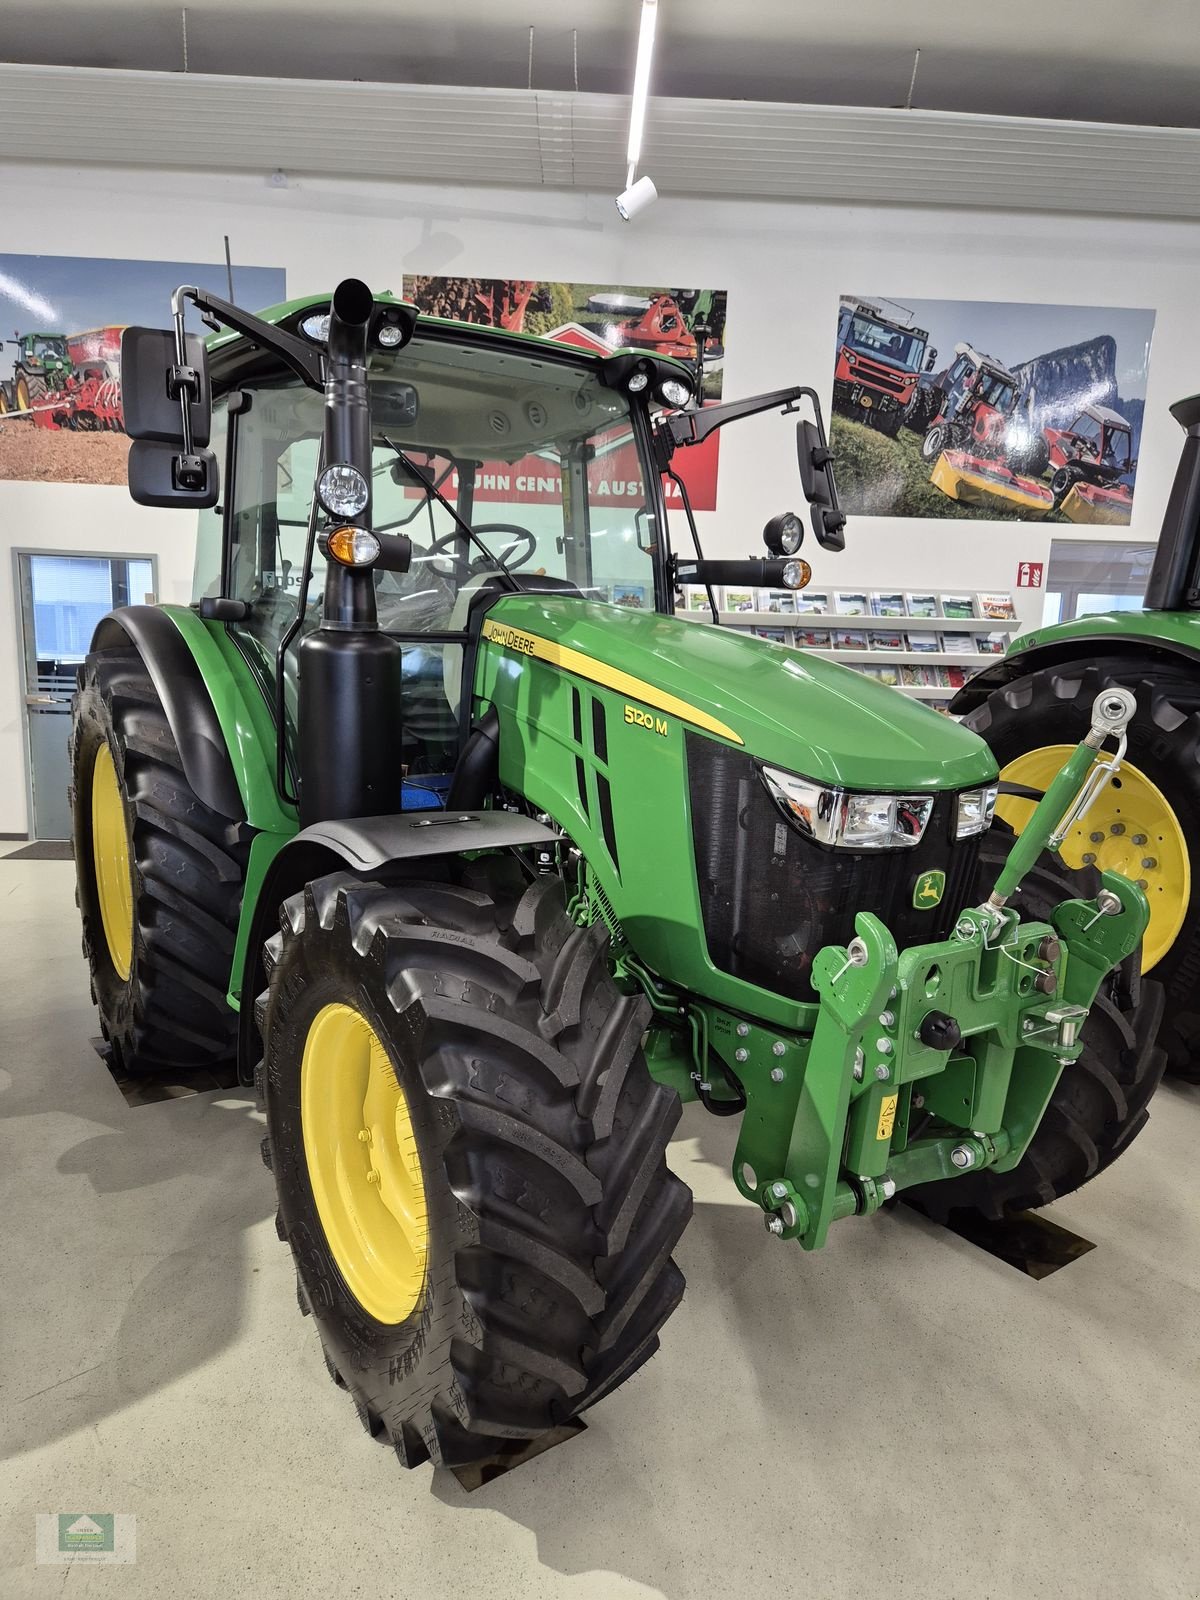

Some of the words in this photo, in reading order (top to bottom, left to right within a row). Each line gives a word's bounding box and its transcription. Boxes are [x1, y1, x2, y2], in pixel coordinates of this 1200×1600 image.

[597, 480, 684, 498] AUSIA
[488, 624, 508, 646] JOHN
[508, 630, 535, 655] DEERE
[624, 703, 654, 730] 5120
[655, 717, 668, 737] M
[431, 930, 476, 948] RADIAL
